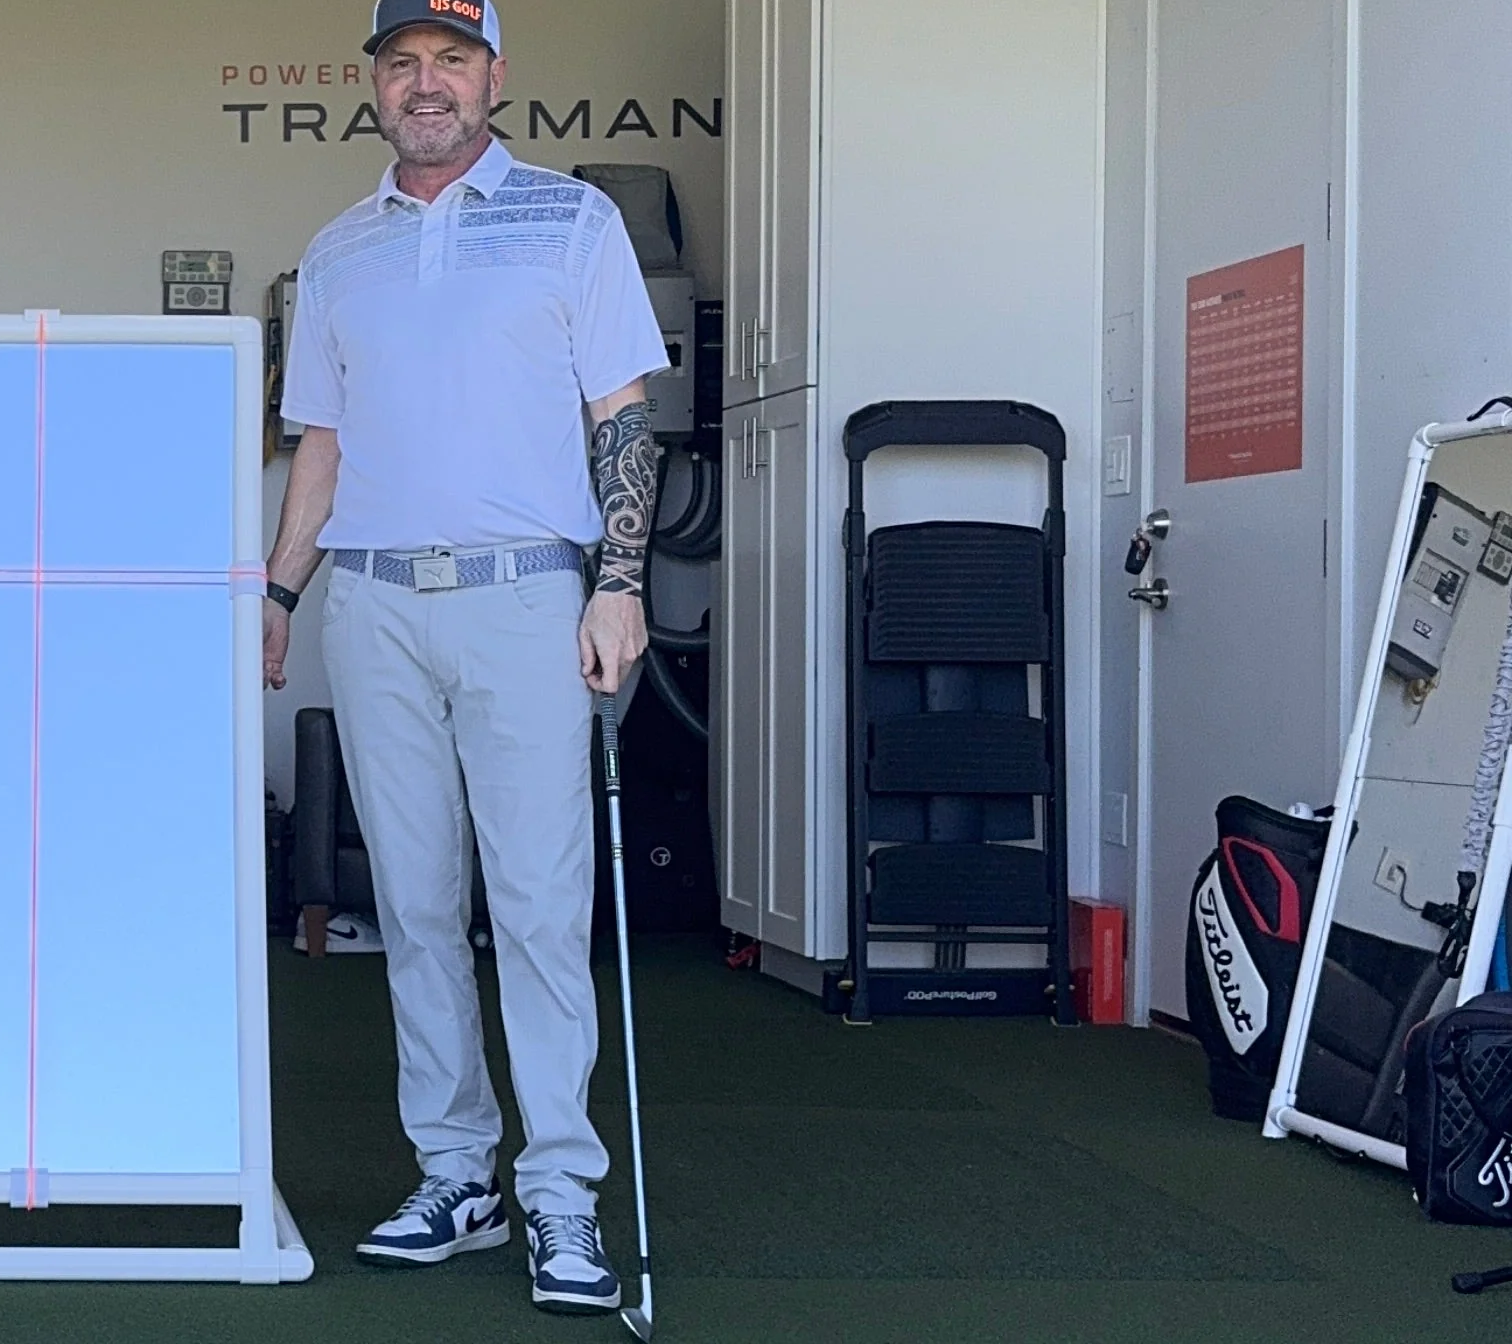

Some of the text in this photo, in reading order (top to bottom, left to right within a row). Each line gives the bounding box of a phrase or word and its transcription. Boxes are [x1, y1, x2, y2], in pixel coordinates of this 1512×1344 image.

[451, 0, 482, 21] GOLF
[222, 98, 723, 144] TRAKMAN
[1199, 887, 1254, 1034] Titleist
